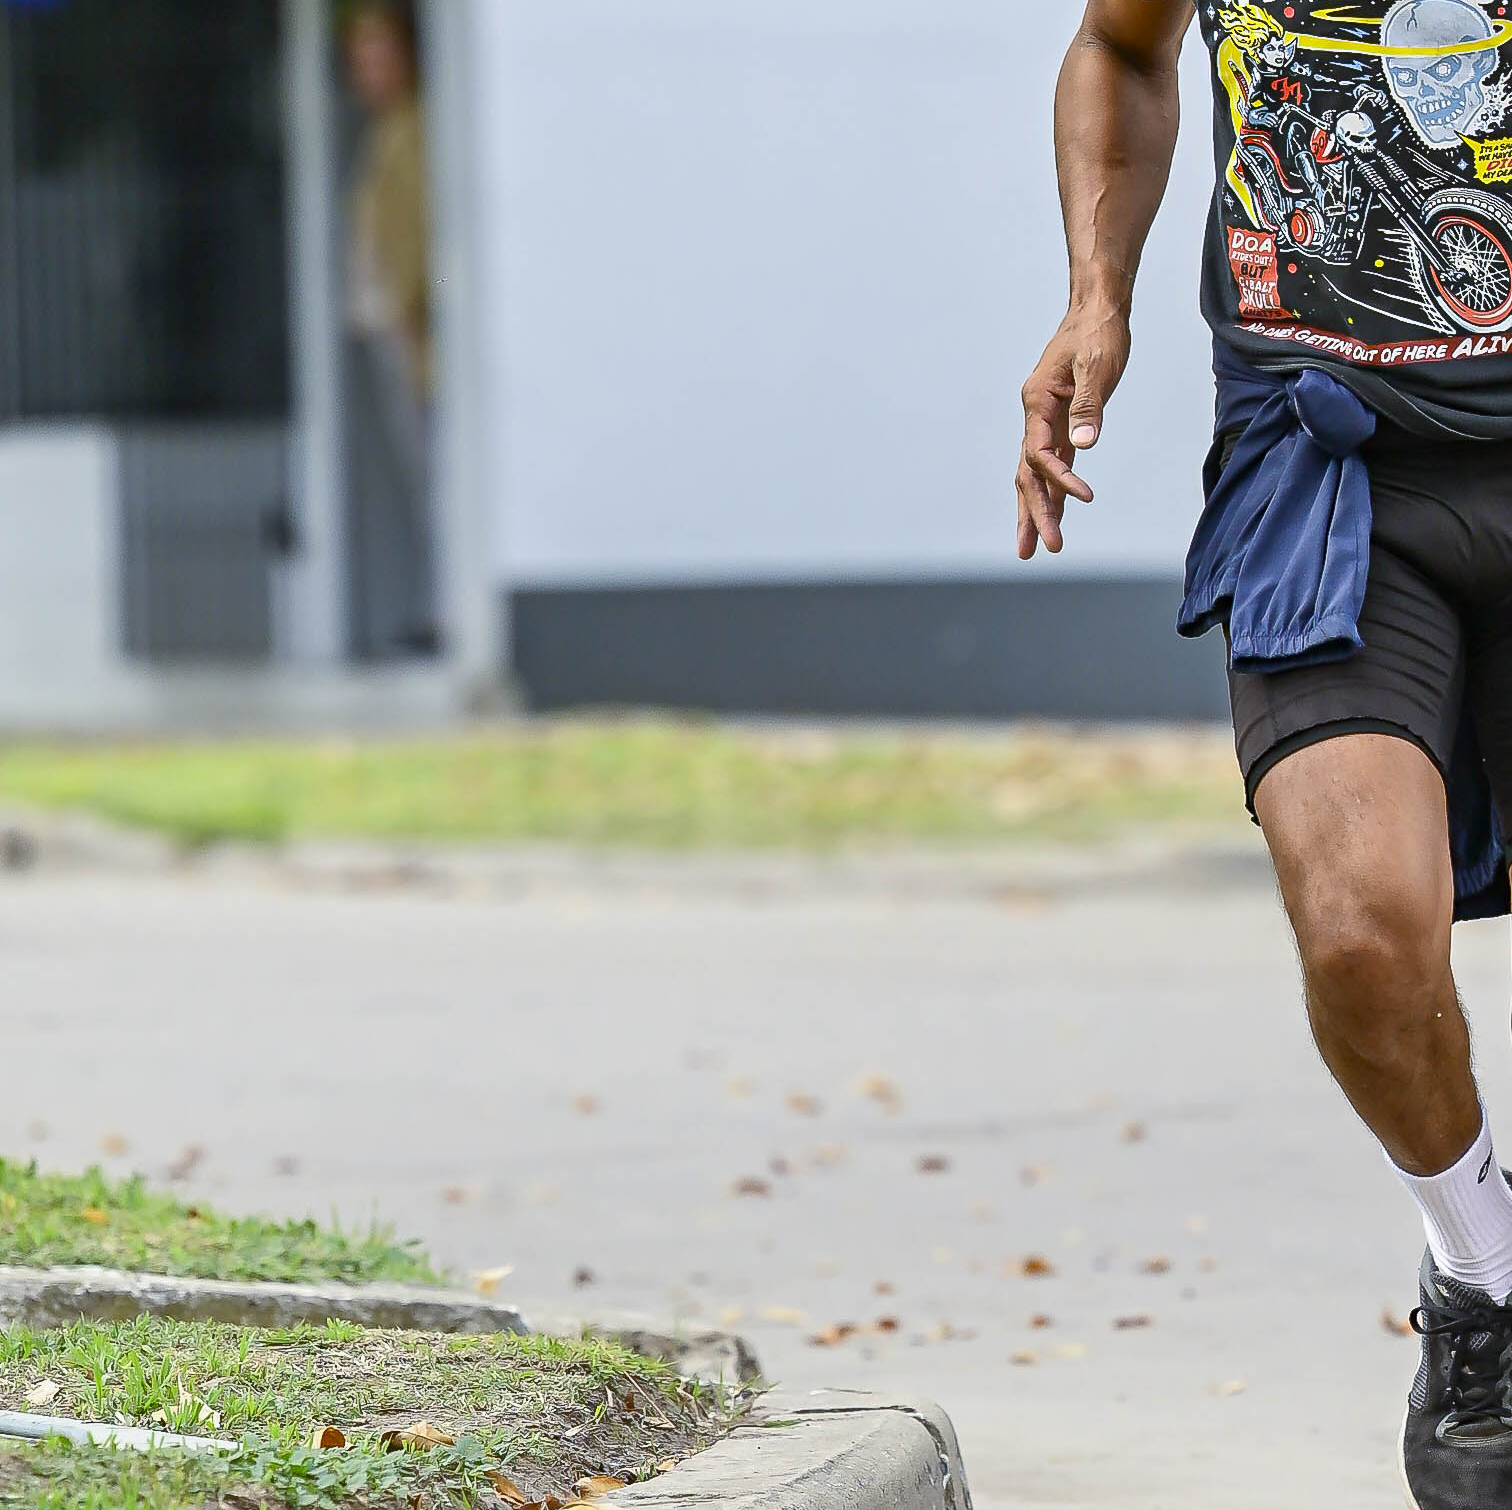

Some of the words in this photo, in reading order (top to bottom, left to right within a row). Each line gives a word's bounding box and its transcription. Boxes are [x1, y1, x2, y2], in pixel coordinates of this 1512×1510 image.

[1482, 171, 1496, 179] MY
[1231, 251, 1254, 263] RIDES
[1254, 254, 1274, 266] OUT!
[1243, 287, 1280, 309] SKULL
[1294, 329, 1353, 356] GETTING
[1352, 345, 1378, 362] OUT
[1380, 346, 1403, 363] OF
[1403, 344, 1449, 361] HERE
